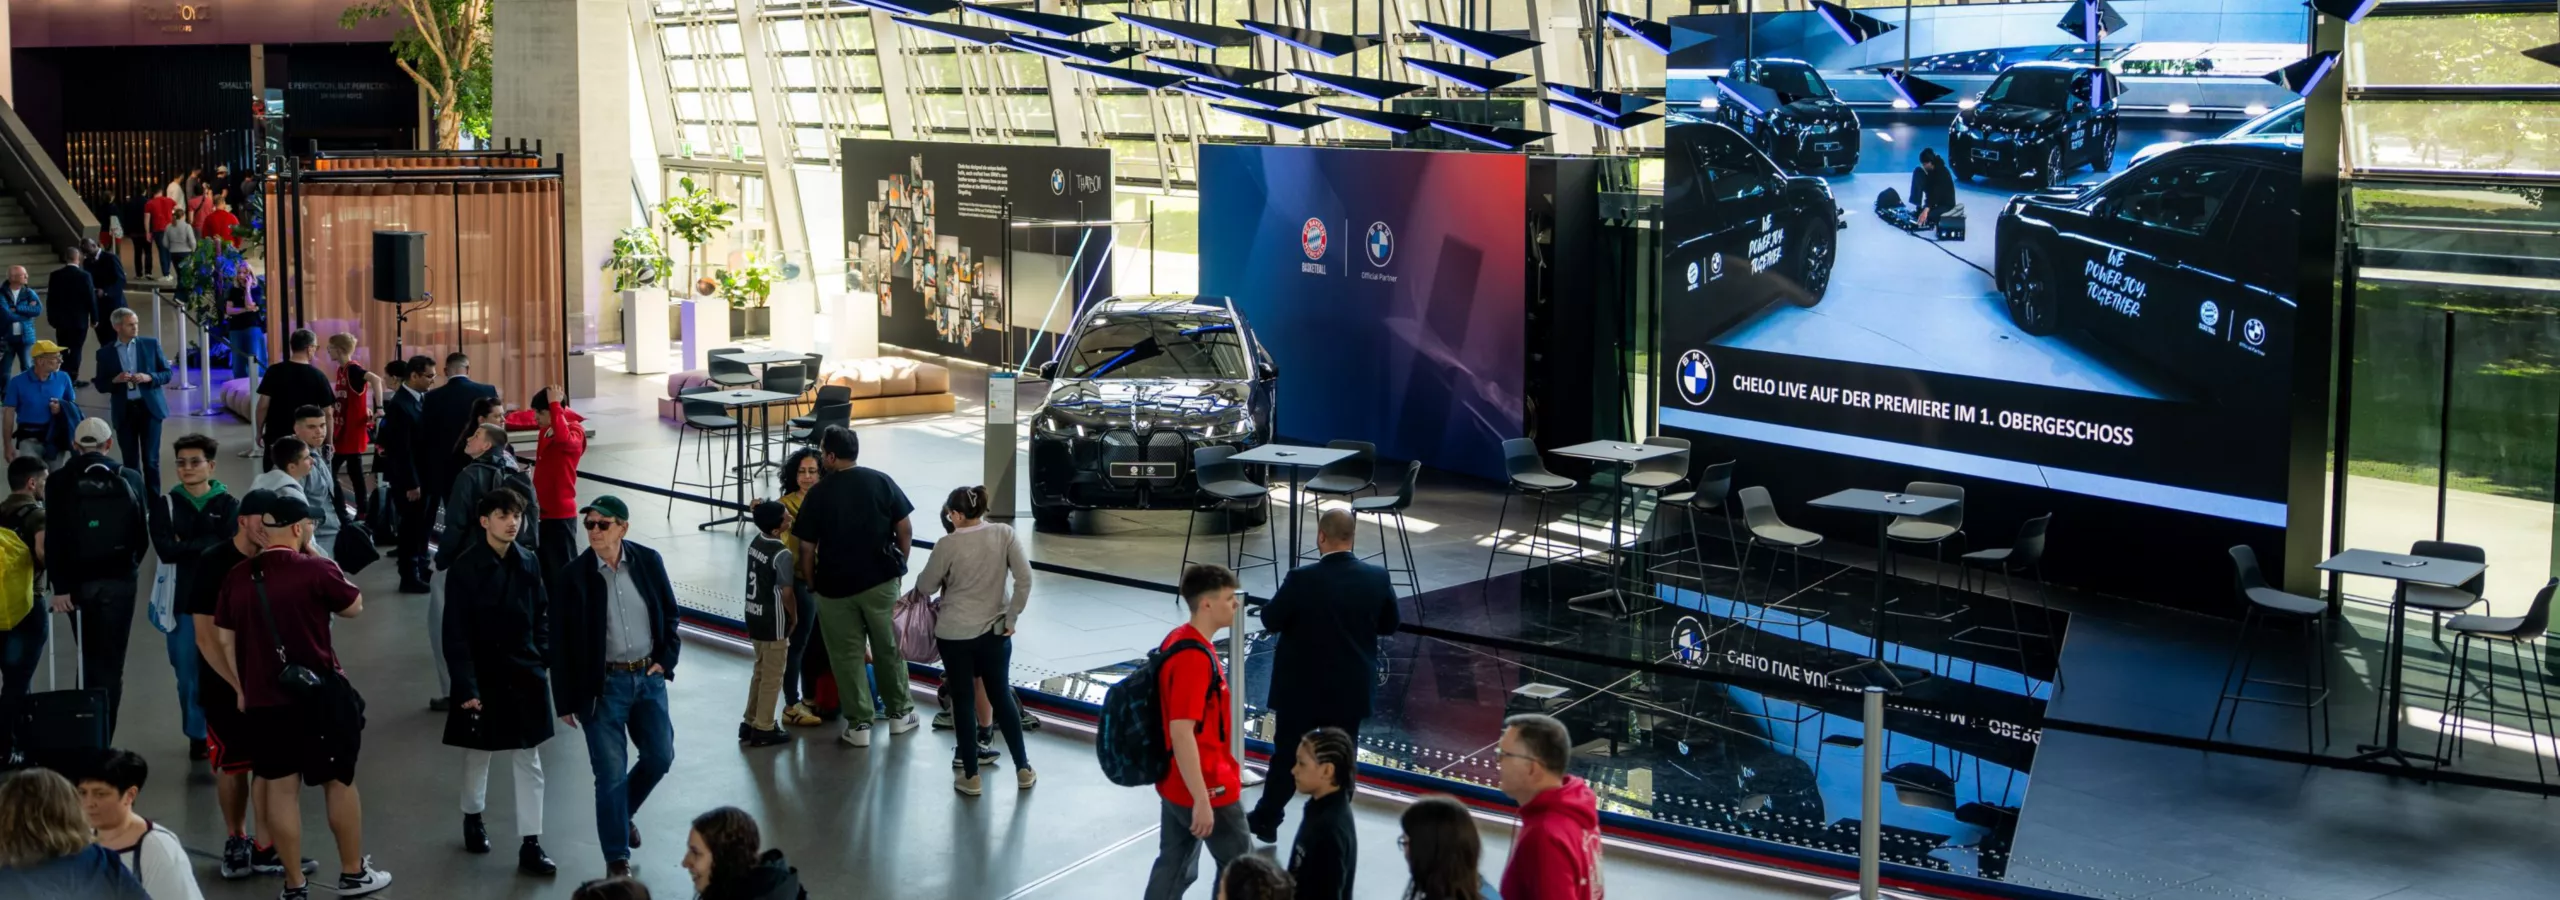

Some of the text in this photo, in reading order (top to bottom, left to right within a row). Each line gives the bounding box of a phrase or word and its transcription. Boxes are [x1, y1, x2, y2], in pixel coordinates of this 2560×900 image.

[2107, 248, 2126, 267] WE
[1379, 273, 1398, 283] Partner
[2085, 260, 2122, 287] POWER
[2087, 281, 2140, 318] TOGETHER.
[1732, 374, 2133, 446] CHELO LIVE AUF DER PREMIERE IM 1. OBERGESCHOSS
[746, 571, 757, 600] 3
